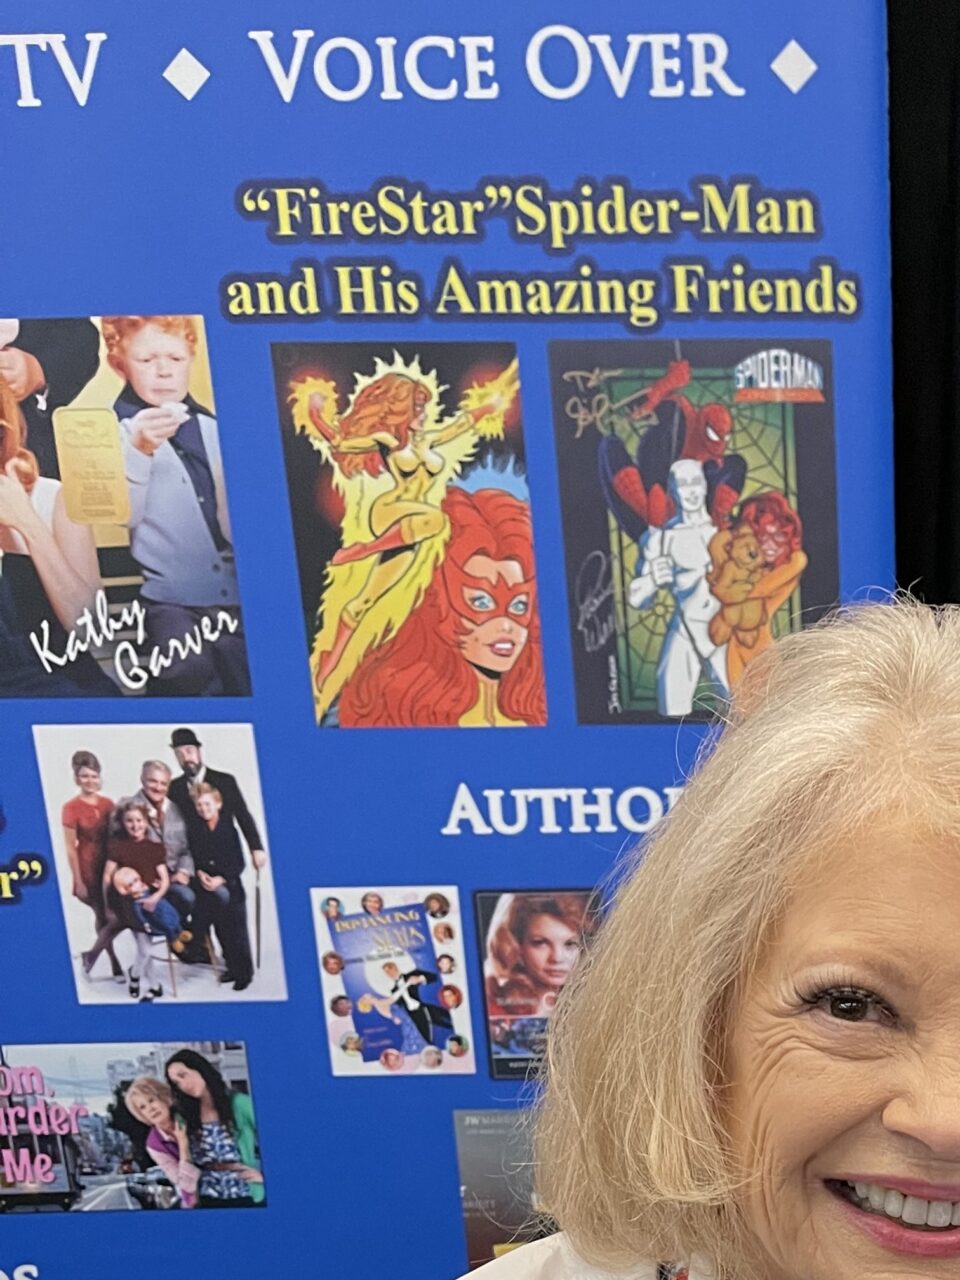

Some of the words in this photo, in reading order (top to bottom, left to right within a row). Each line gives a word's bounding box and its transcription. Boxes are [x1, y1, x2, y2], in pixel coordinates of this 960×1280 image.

[0, 32, 107, 108] TV
[249, 27, 499, 103] VOICE
[525, 24, 745, 98] OVER
[227, 268, 318, 316] and
[335, 266, 419, 315] His
[436, 267, 659, 328] Amazing
[669, 264, 858, 316] Friends
[29, 588, 147, 674] Kathy
[114, 610, 239, 690] Garver
[2, 1147, 56, 1184] Me
